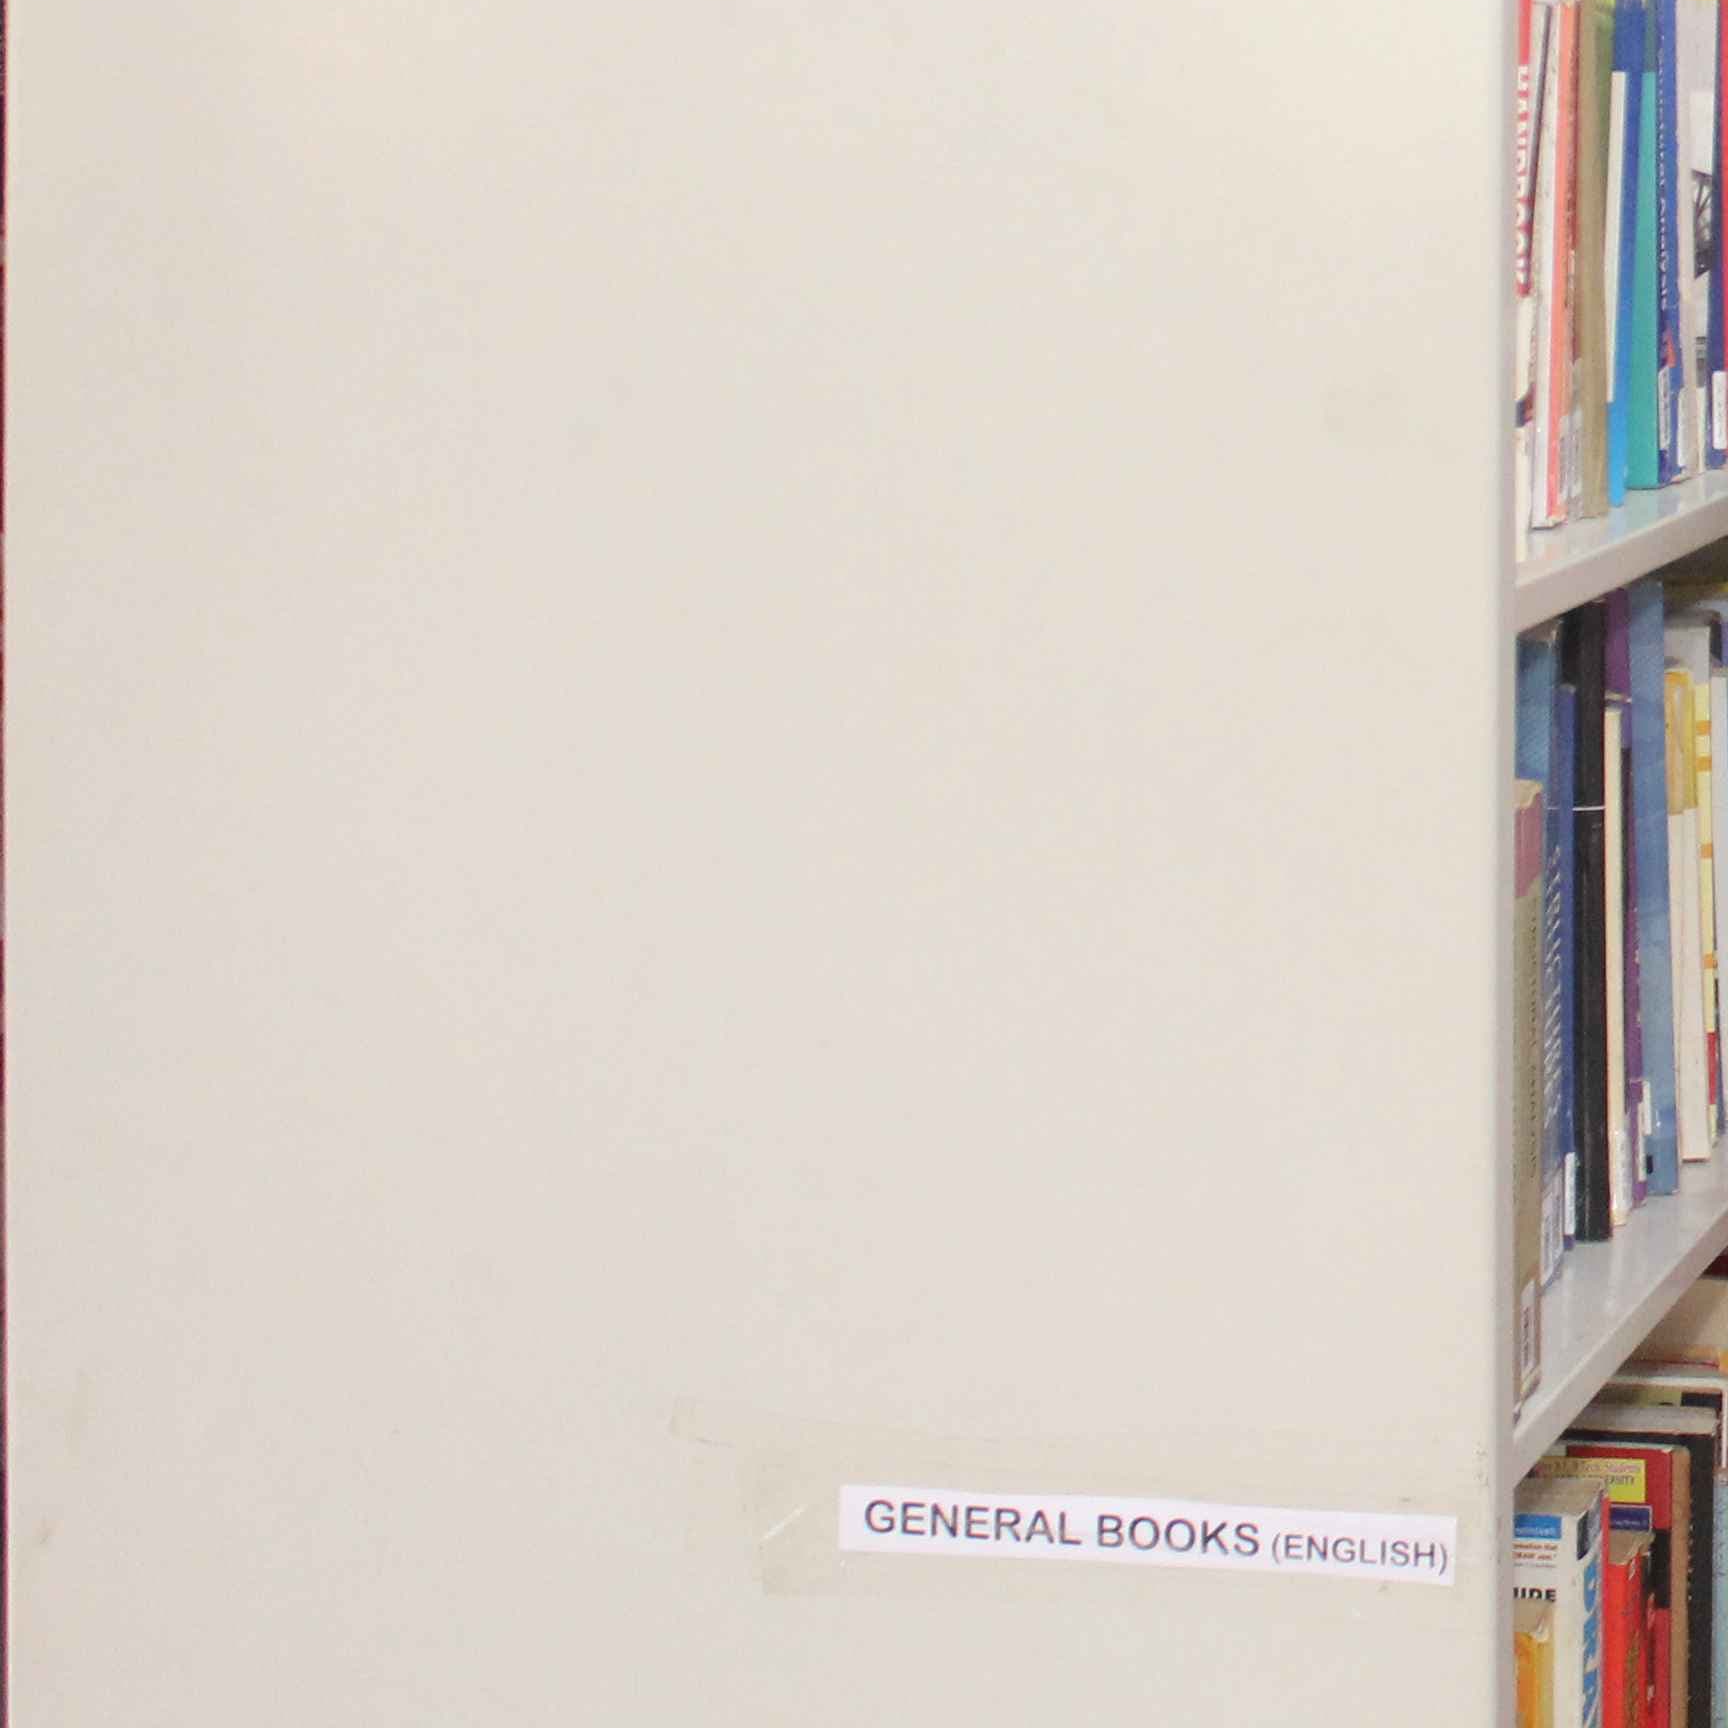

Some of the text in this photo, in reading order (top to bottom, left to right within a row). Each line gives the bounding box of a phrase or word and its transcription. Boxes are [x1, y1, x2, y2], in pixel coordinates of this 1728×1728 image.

[863, 1498, 1450, 1576] GENERAL BOOKS (ENGLISH)
